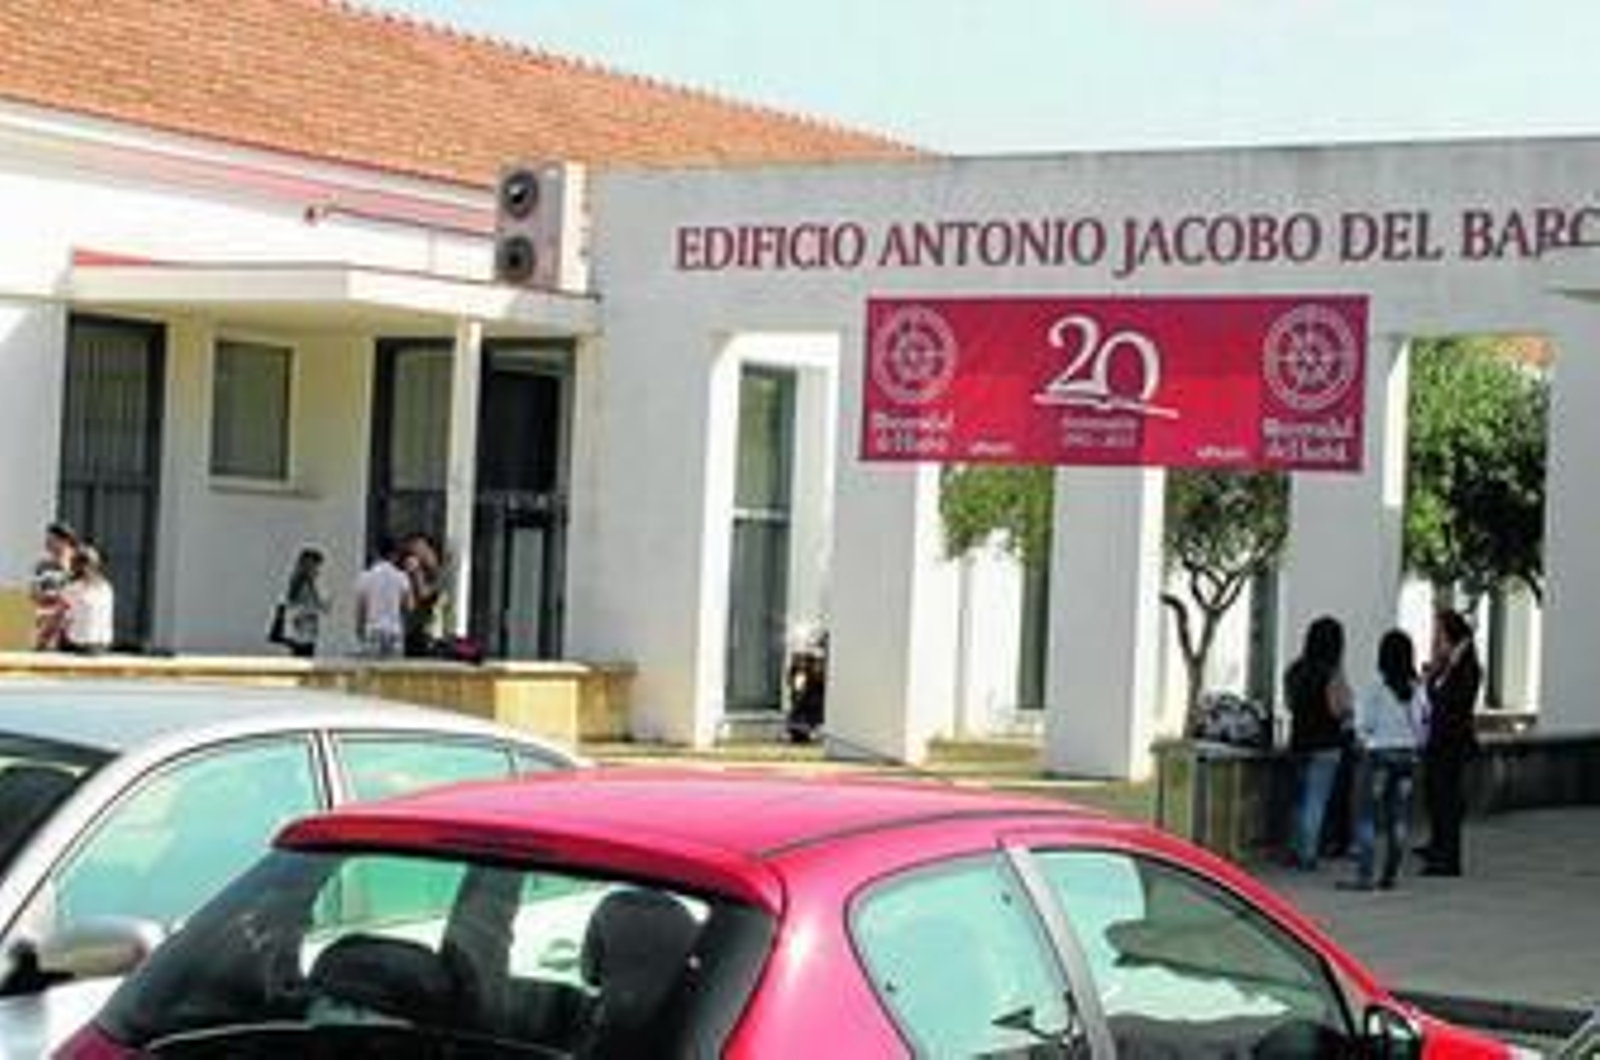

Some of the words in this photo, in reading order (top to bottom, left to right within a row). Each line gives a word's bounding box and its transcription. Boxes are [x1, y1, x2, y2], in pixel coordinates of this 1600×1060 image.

[676, 222, 866, 271] EDIFICIO
[878, 217, 1107, 267] ANTONIO
[1113, 213, 1322, 277] JACOBO
[1340, 211, 1444, 262] DEL
[1045, 314, 1161, 402] 20
